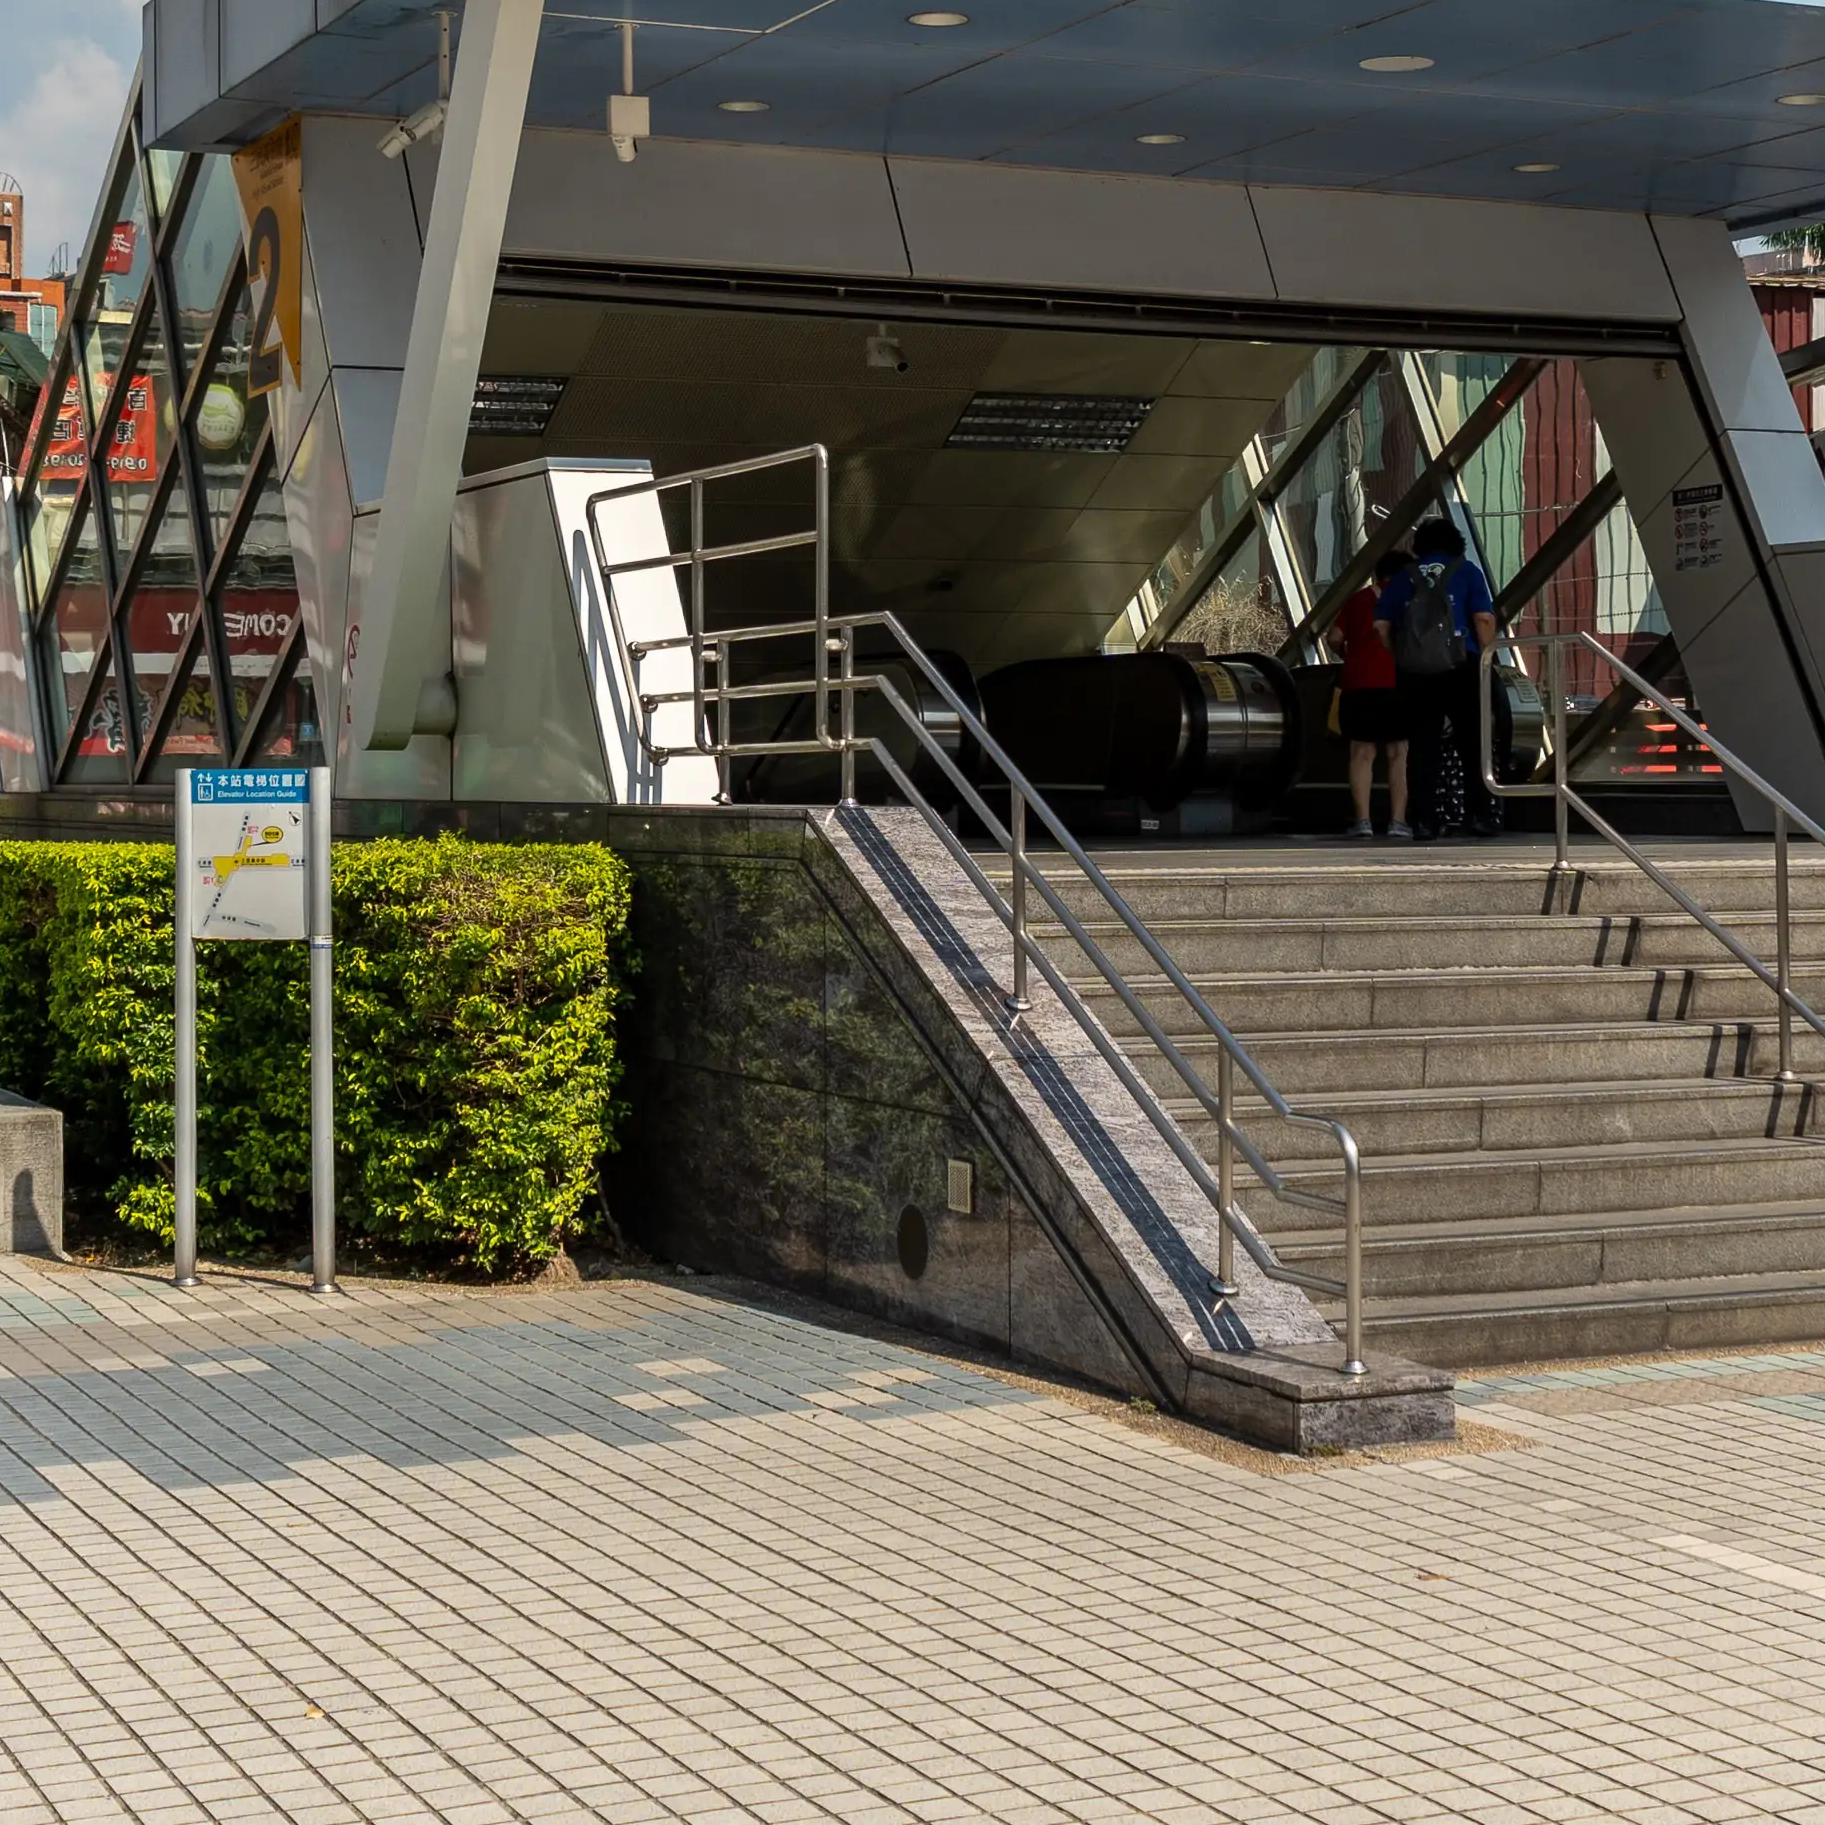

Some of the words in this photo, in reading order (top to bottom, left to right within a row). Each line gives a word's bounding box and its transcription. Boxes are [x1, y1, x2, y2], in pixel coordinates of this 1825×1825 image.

[248, 205, 282, 393] 2
[218, 790, 245, 798] Elevator
[246, 790, 275, 798] Location
[277, 790, 297, 798] Guide
